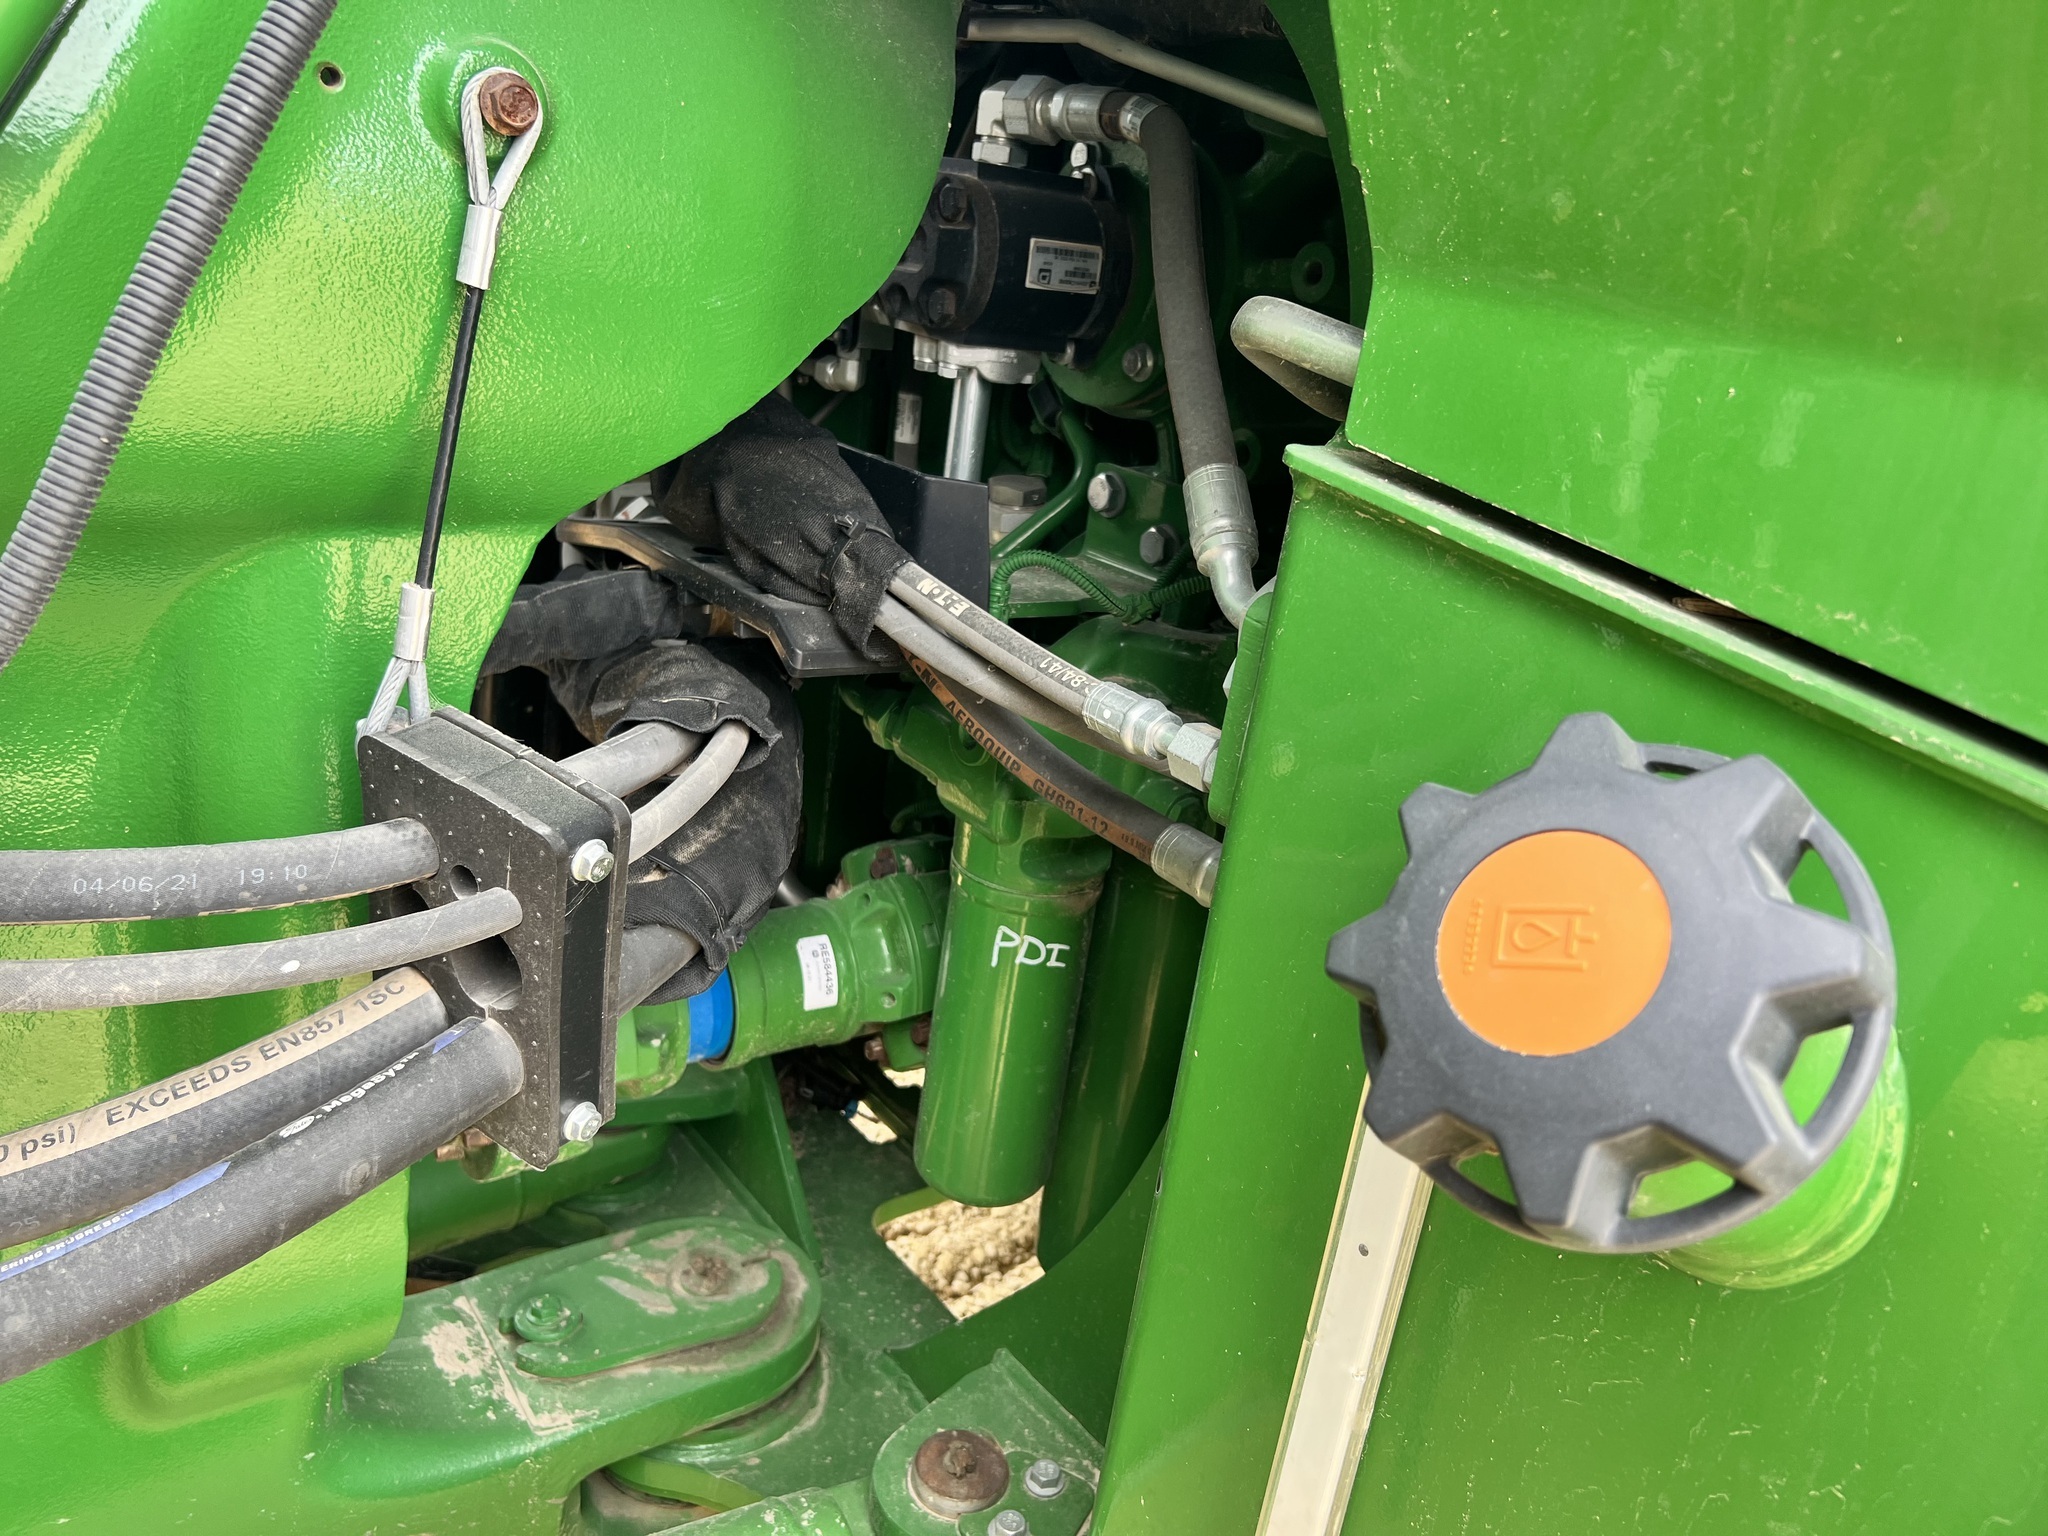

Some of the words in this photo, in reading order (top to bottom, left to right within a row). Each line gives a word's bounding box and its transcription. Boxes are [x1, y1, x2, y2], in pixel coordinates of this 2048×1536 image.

[73, 873, 197, 895] 04/06/21
[238, 864, 308, 885] 19:10
[991, 925, 1070, 967] PDI
[21, 1122, 76, 1161] psi)
[106, 1056, 252, 1126] EXCEEDS
[258, 1009, 346, 1061] EN857
[354, 980, 406, 1012] 1SC
